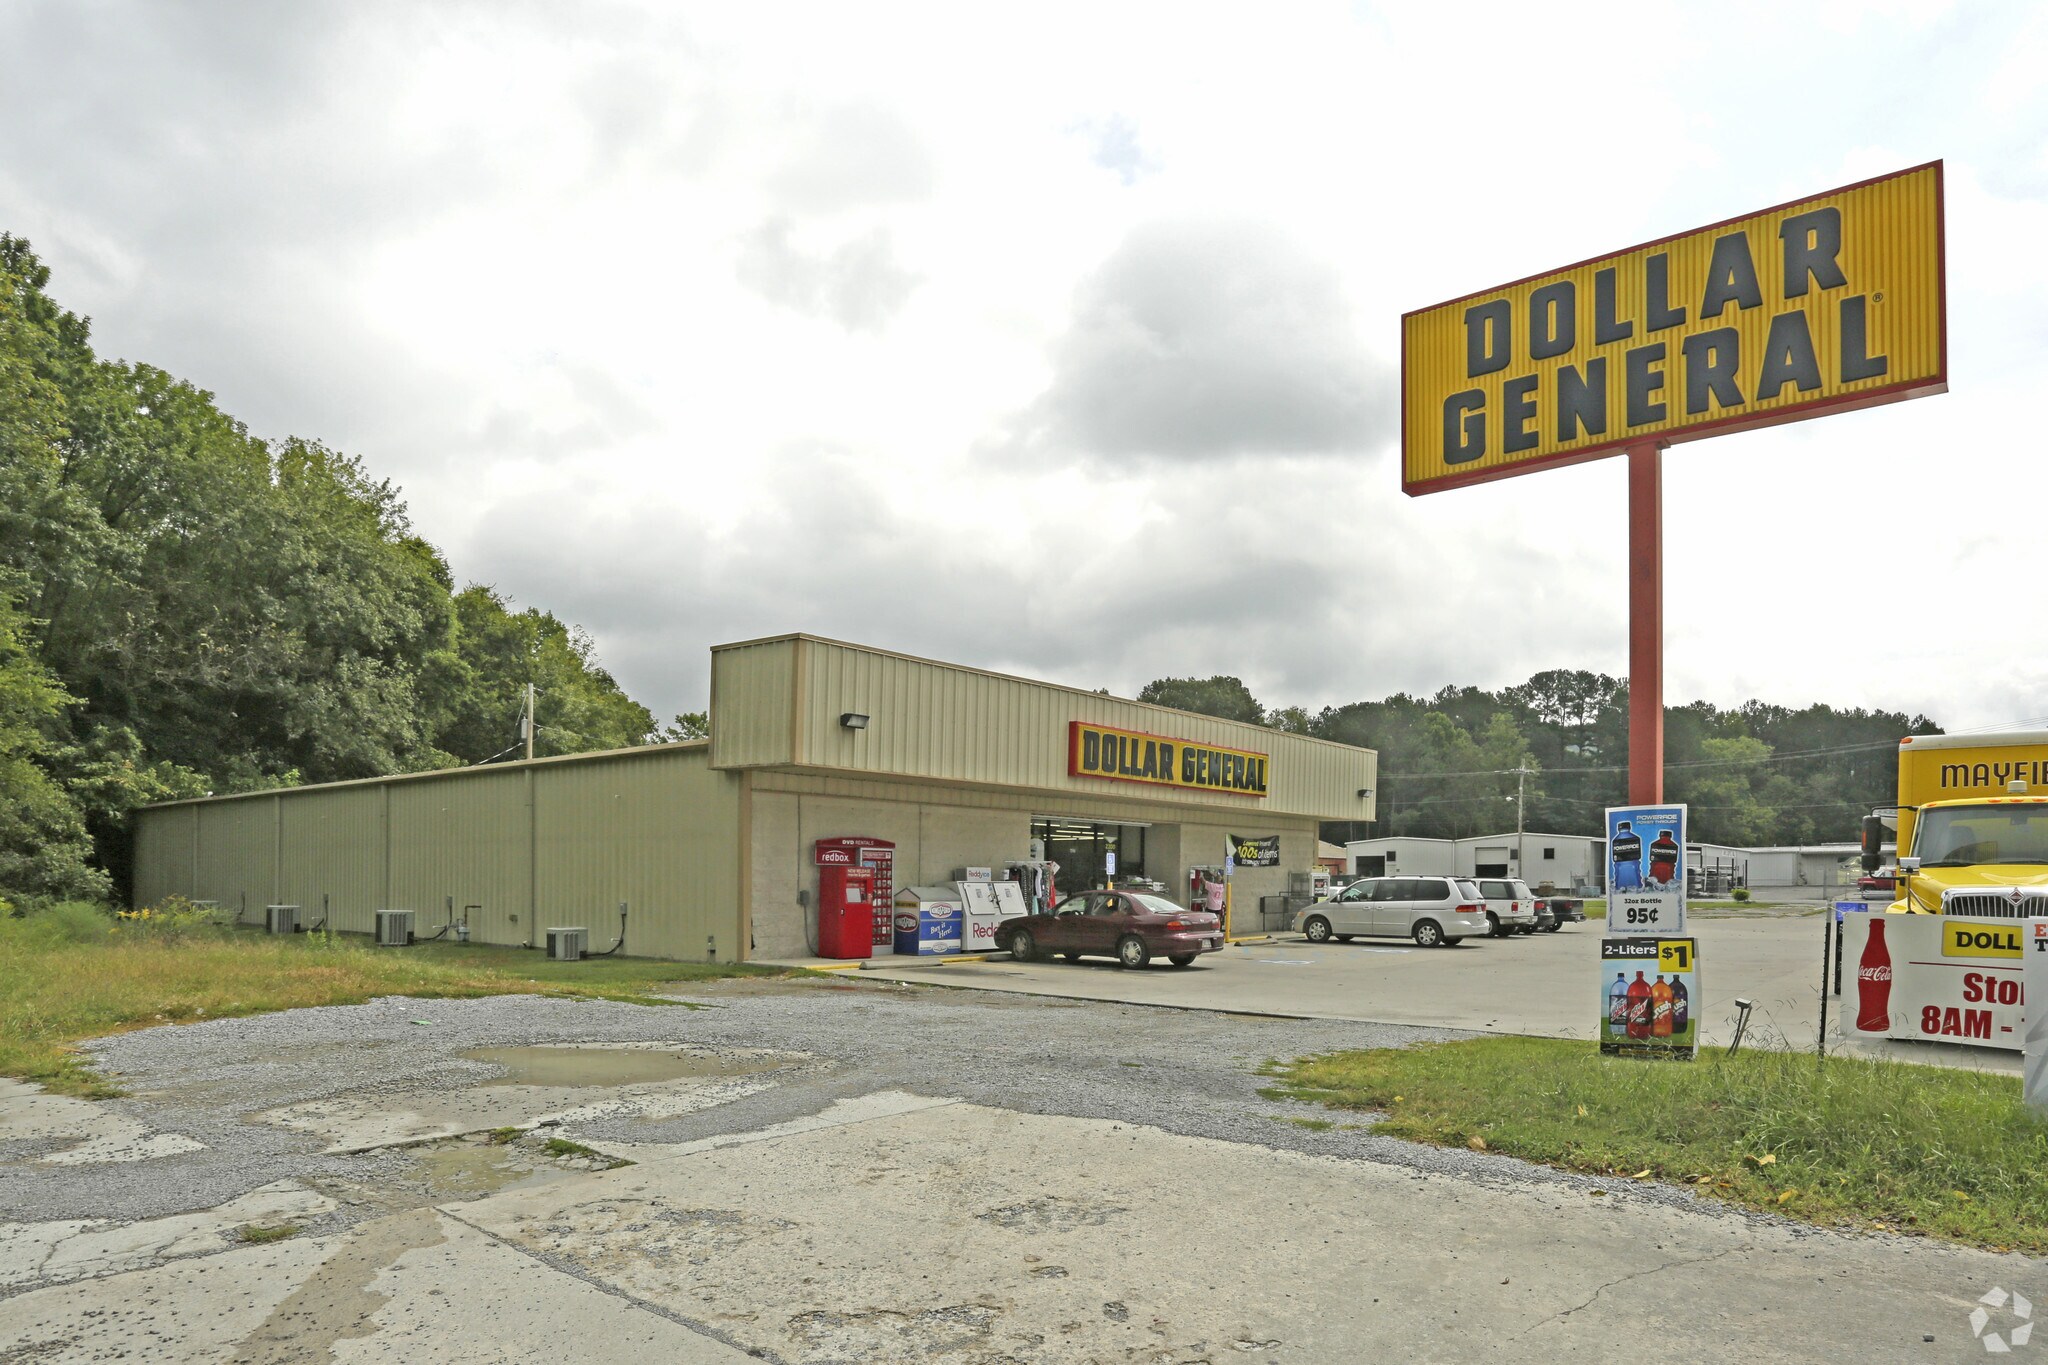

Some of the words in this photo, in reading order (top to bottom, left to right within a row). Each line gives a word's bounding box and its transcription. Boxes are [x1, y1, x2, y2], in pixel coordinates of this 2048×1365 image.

[1463, 206, 1848, 379] DOLLAR
[1442, 293, 1888, 466] GENERAL
[1083, 729, 1174, 781] DOLLAR
[1181, 746, 1267, 792] GENERAL
[822, 852, 850, 862] redbox
[1238, 846, 1258, 859] 100s
[1626, 907, 1659, 924] 95¢
[1956, 931, 2023, 951] DOLL
[1604, 945, 1657, 956] 2-Liters
[1661, 945, 1688, 968] $1
[1962, 972, 2024, 1007] Sto
[1920, 1005, 1993, 1040] 8AM
